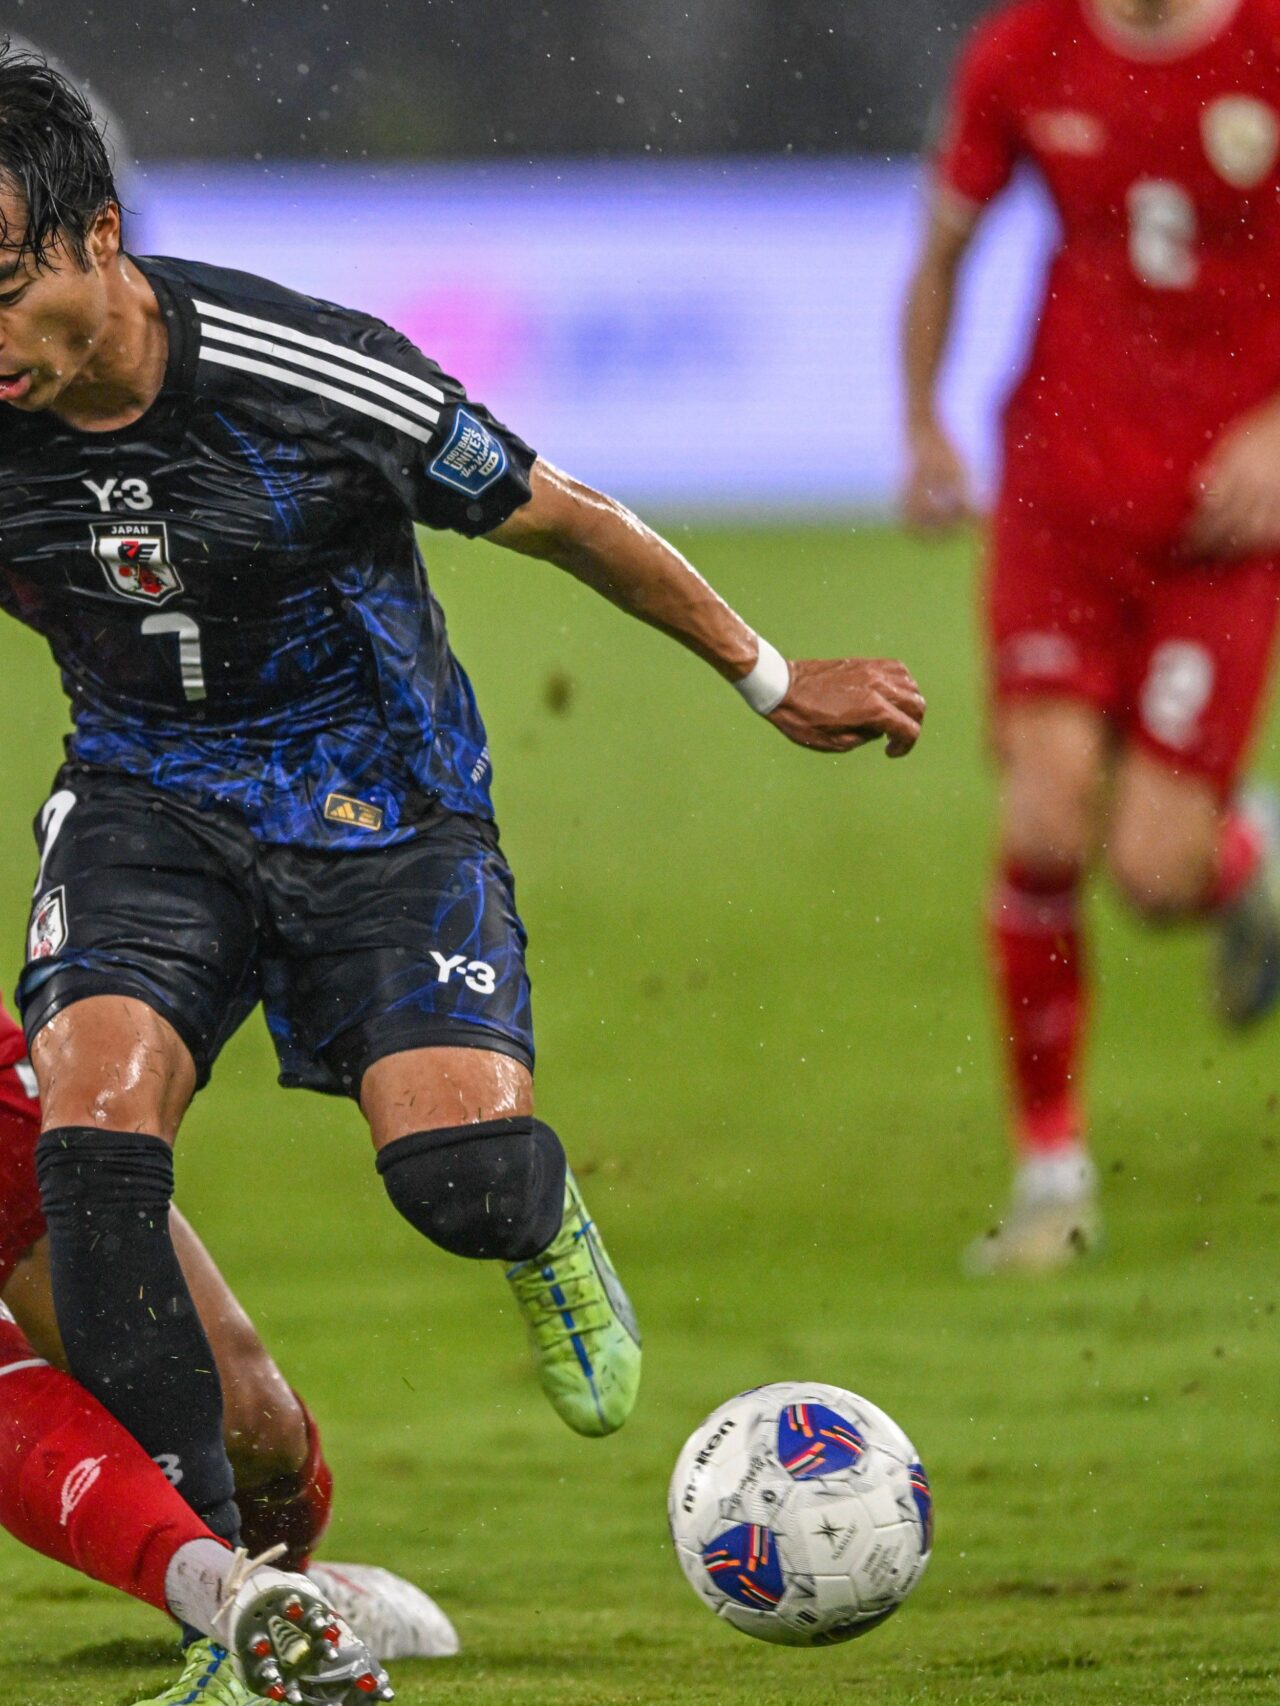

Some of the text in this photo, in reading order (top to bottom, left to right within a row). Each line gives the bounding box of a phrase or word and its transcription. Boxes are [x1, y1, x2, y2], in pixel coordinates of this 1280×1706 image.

[443, 427, 472, 465] FOOTBALL
[451, 429, 482, 470] UNITES
[483, 456, 497, 473] FIFA
[81, 478, 153, 512] Y-3
[111, 526, 149, 535] JAPAN
[141, 612, 207, 701] 7
[429, 950, 496, 995] Y-3
